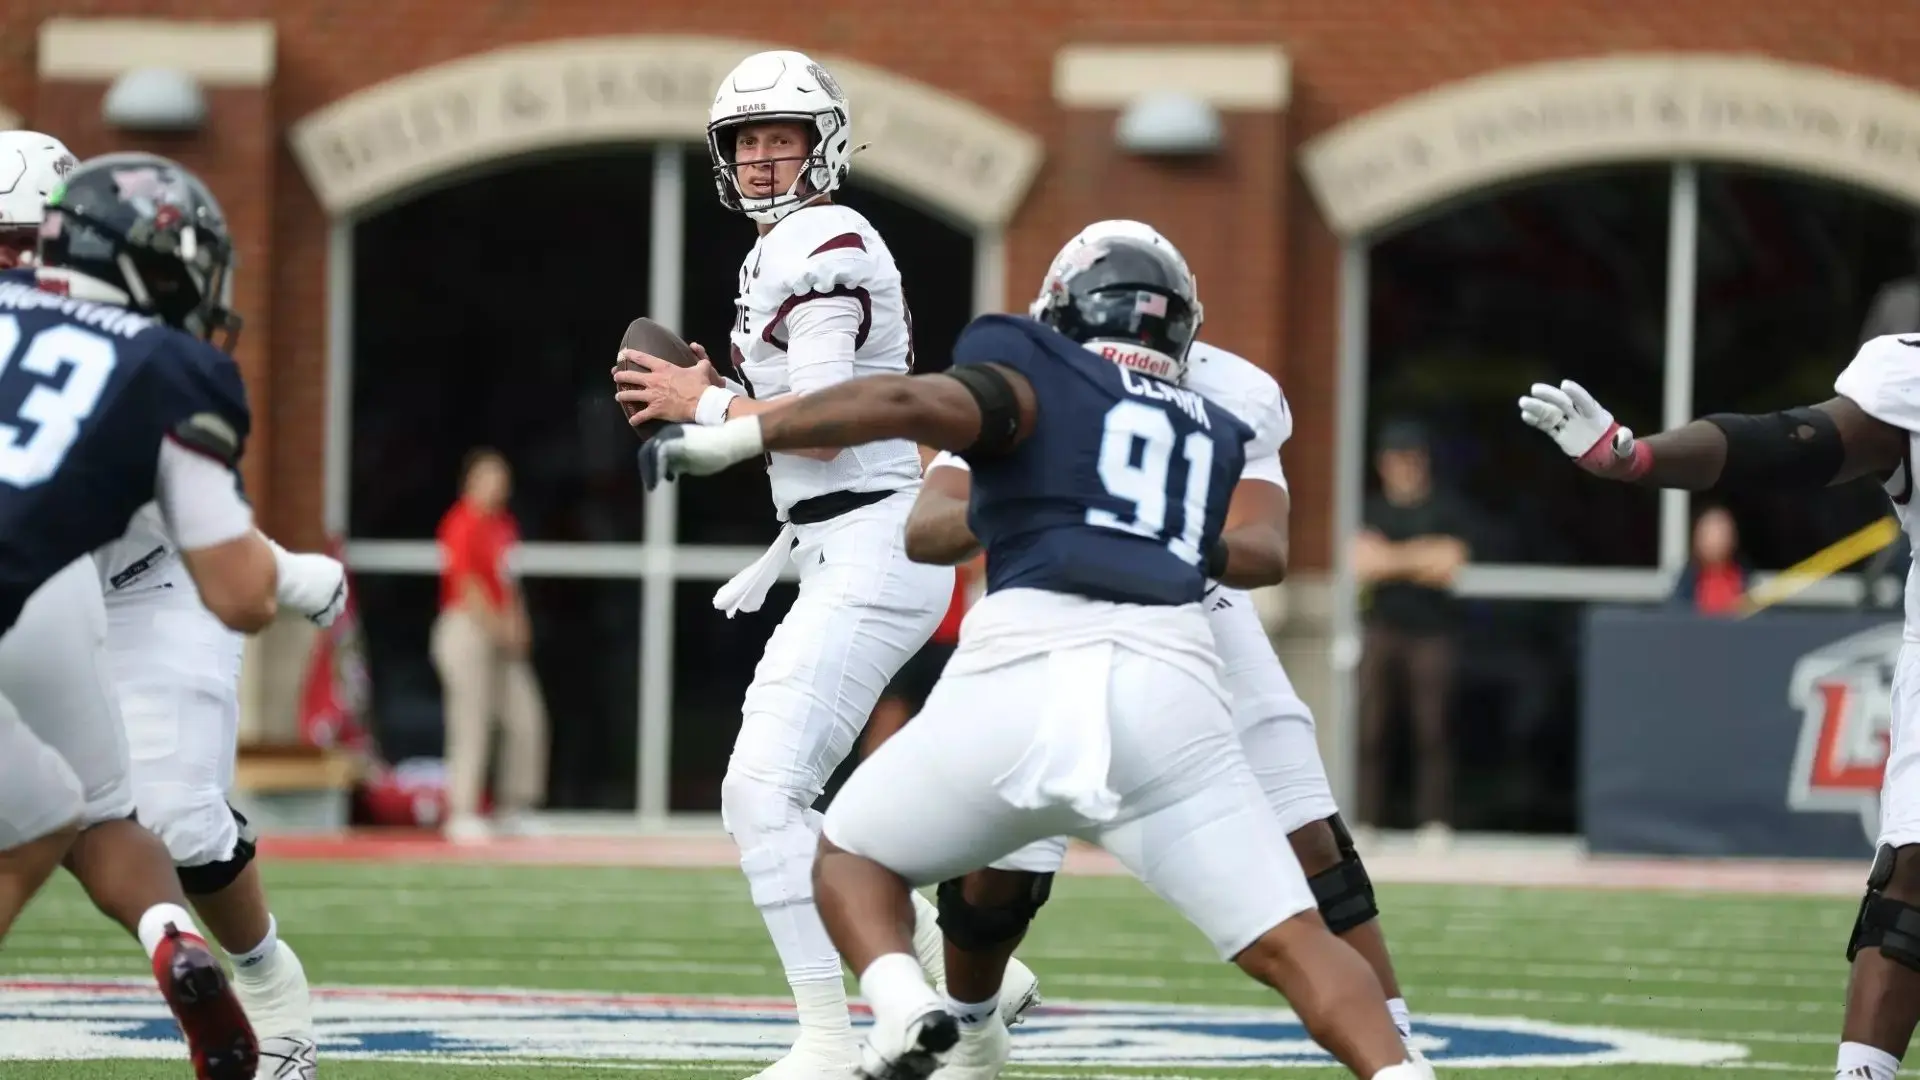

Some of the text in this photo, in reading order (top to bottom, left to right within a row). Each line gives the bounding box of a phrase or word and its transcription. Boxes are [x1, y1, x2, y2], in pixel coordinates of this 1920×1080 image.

[736, 103, 766, 113] BEARS
[1101, 346, 1170, 376] Riddell
[1085, 400, 1213, 567] 91
